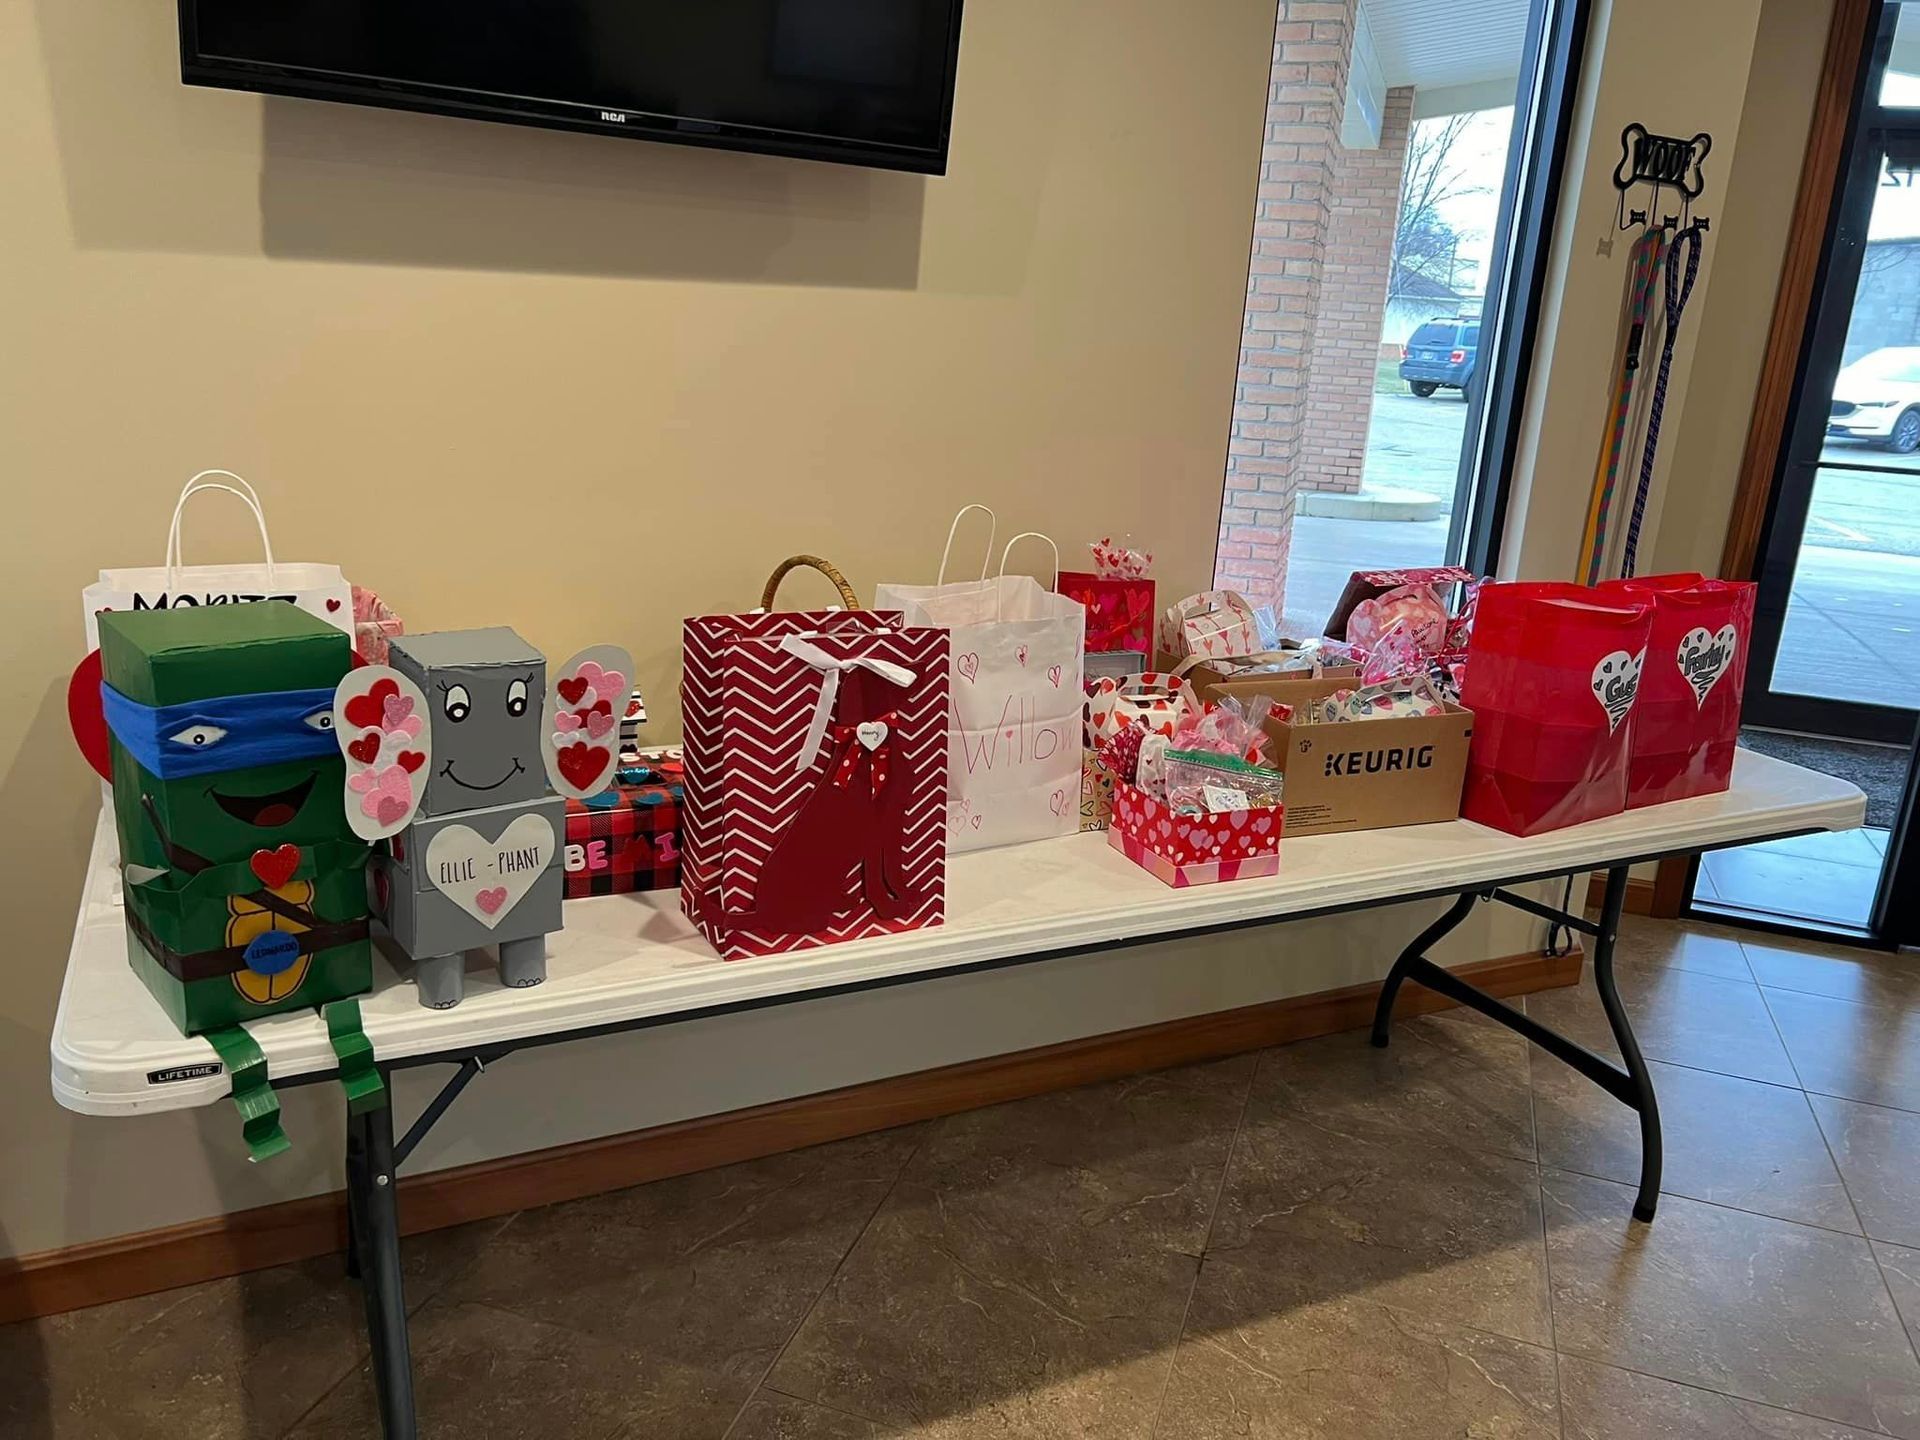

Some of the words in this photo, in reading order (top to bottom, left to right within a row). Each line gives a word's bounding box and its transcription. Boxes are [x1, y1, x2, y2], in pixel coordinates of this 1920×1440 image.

[601, 111, 625, 123] RCA
[1633, 138, 1697, 183] WOOF
[1605, 673, 1639, 702] Gus
[953, 694, 1077, 774] Willow
[1325, 745, 1434, 777] KEURIG
[498, 846, 539, 875] PHANT
[564, 840, 608, 872] BE
[158, 1066, 213, 1081] LIFETIME
